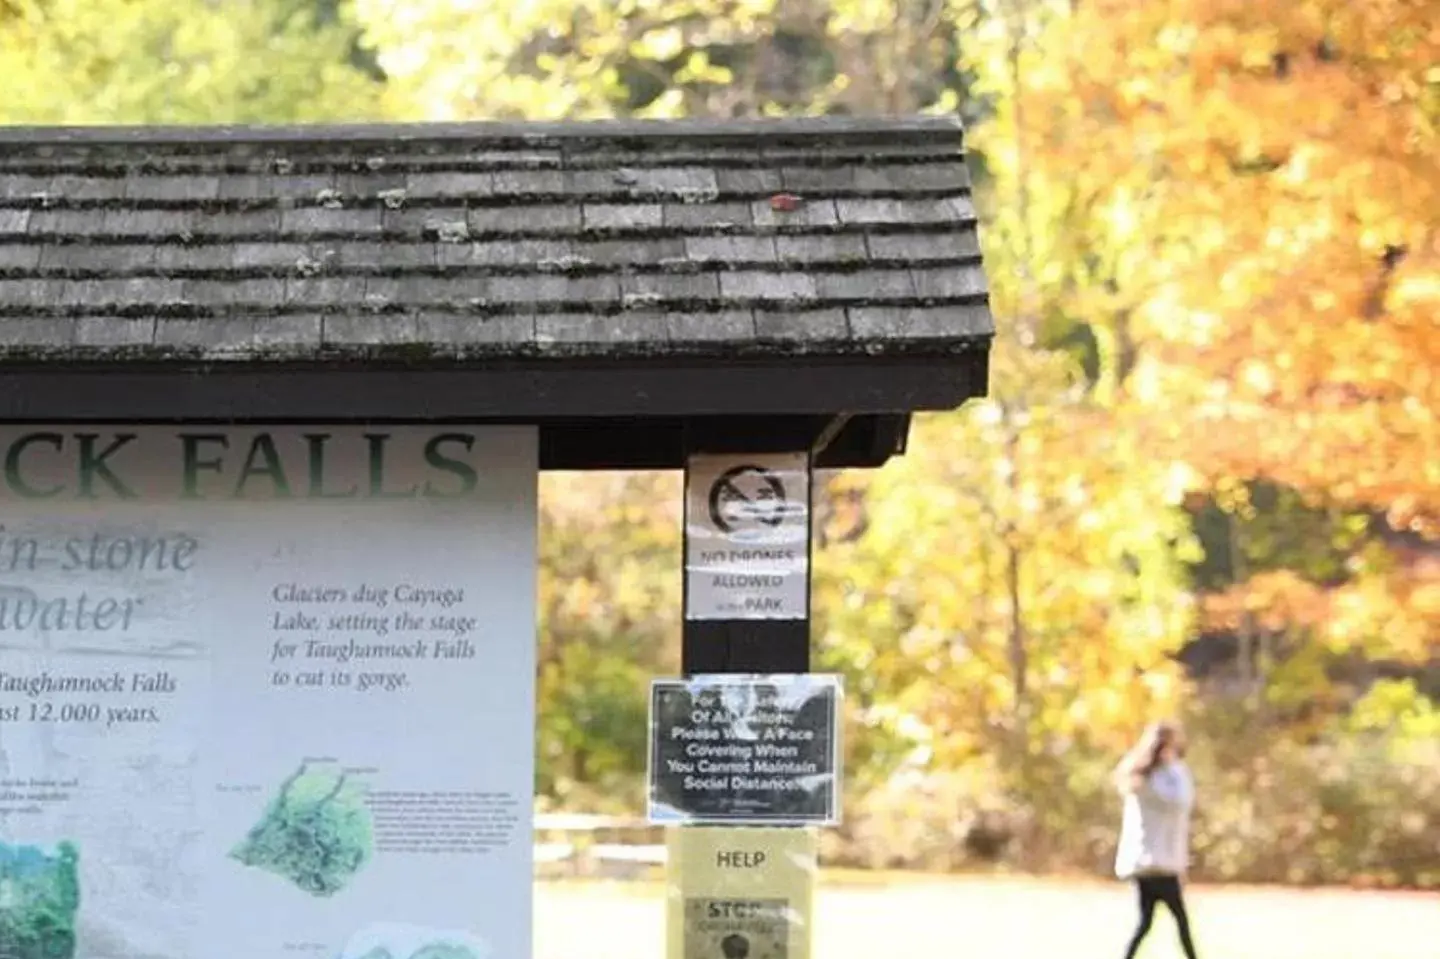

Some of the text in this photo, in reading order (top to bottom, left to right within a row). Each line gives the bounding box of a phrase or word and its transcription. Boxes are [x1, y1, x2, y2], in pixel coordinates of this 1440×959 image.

[176, 432, 480, 500] FALLS
[61, 533, 199, 573] stone
[271, 583, 465, 608] Glaciers dug Cayuga
[744, 597, 784, 613] PARK
[326, 612, 390, 636] setting
[394, 611, 425, 631] the
[429, 615, 477, 636] stage
[271, 638, 477, 664] for Taughannock Falls
[131, 671, 177, 693] Falls
[272, 670, 290, 686] to
[295, 671, 325, 687] cut
[330, 671, 352, 687] its
[686, 743, 799, 761] Covering When
[667, 759, 817, 774] You Cannot Maintain
[684, 775, 729, 791] Social
[716, 850, 767, 869] HELP
